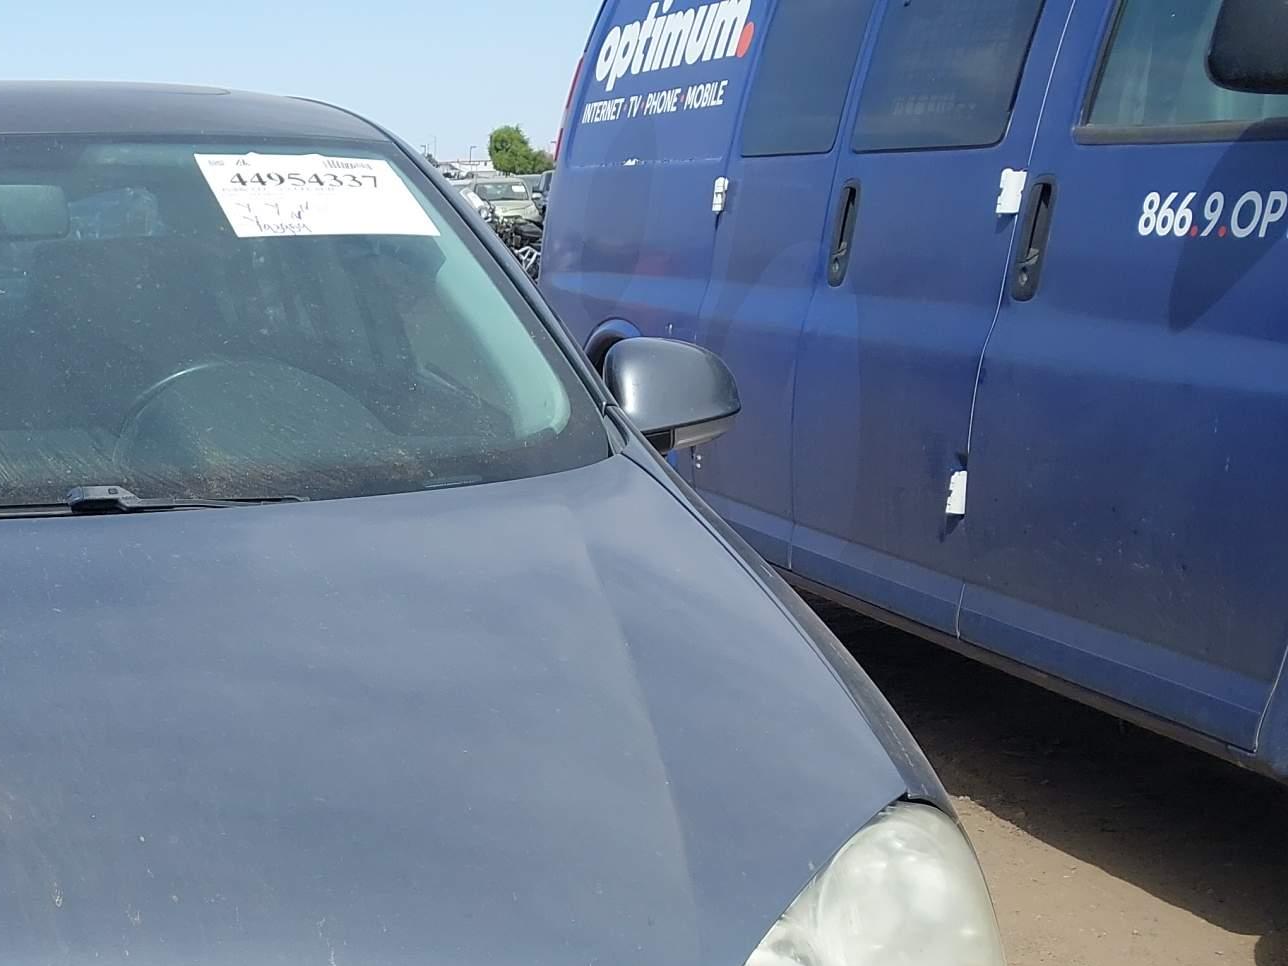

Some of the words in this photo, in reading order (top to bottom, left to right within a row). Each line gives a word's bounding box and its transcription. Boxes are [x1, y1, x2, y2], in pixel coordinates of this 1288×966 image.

[581, 98, 625, 124] INTERNET
[627, 95, 642, 118] TV
[643, 88, 682, 116] PHONE
[683, 79, 729, 111] MOBILE
[230, 172, 378, 188] 44954337
[1137, 190, 1288, 239] 866.9.OP
